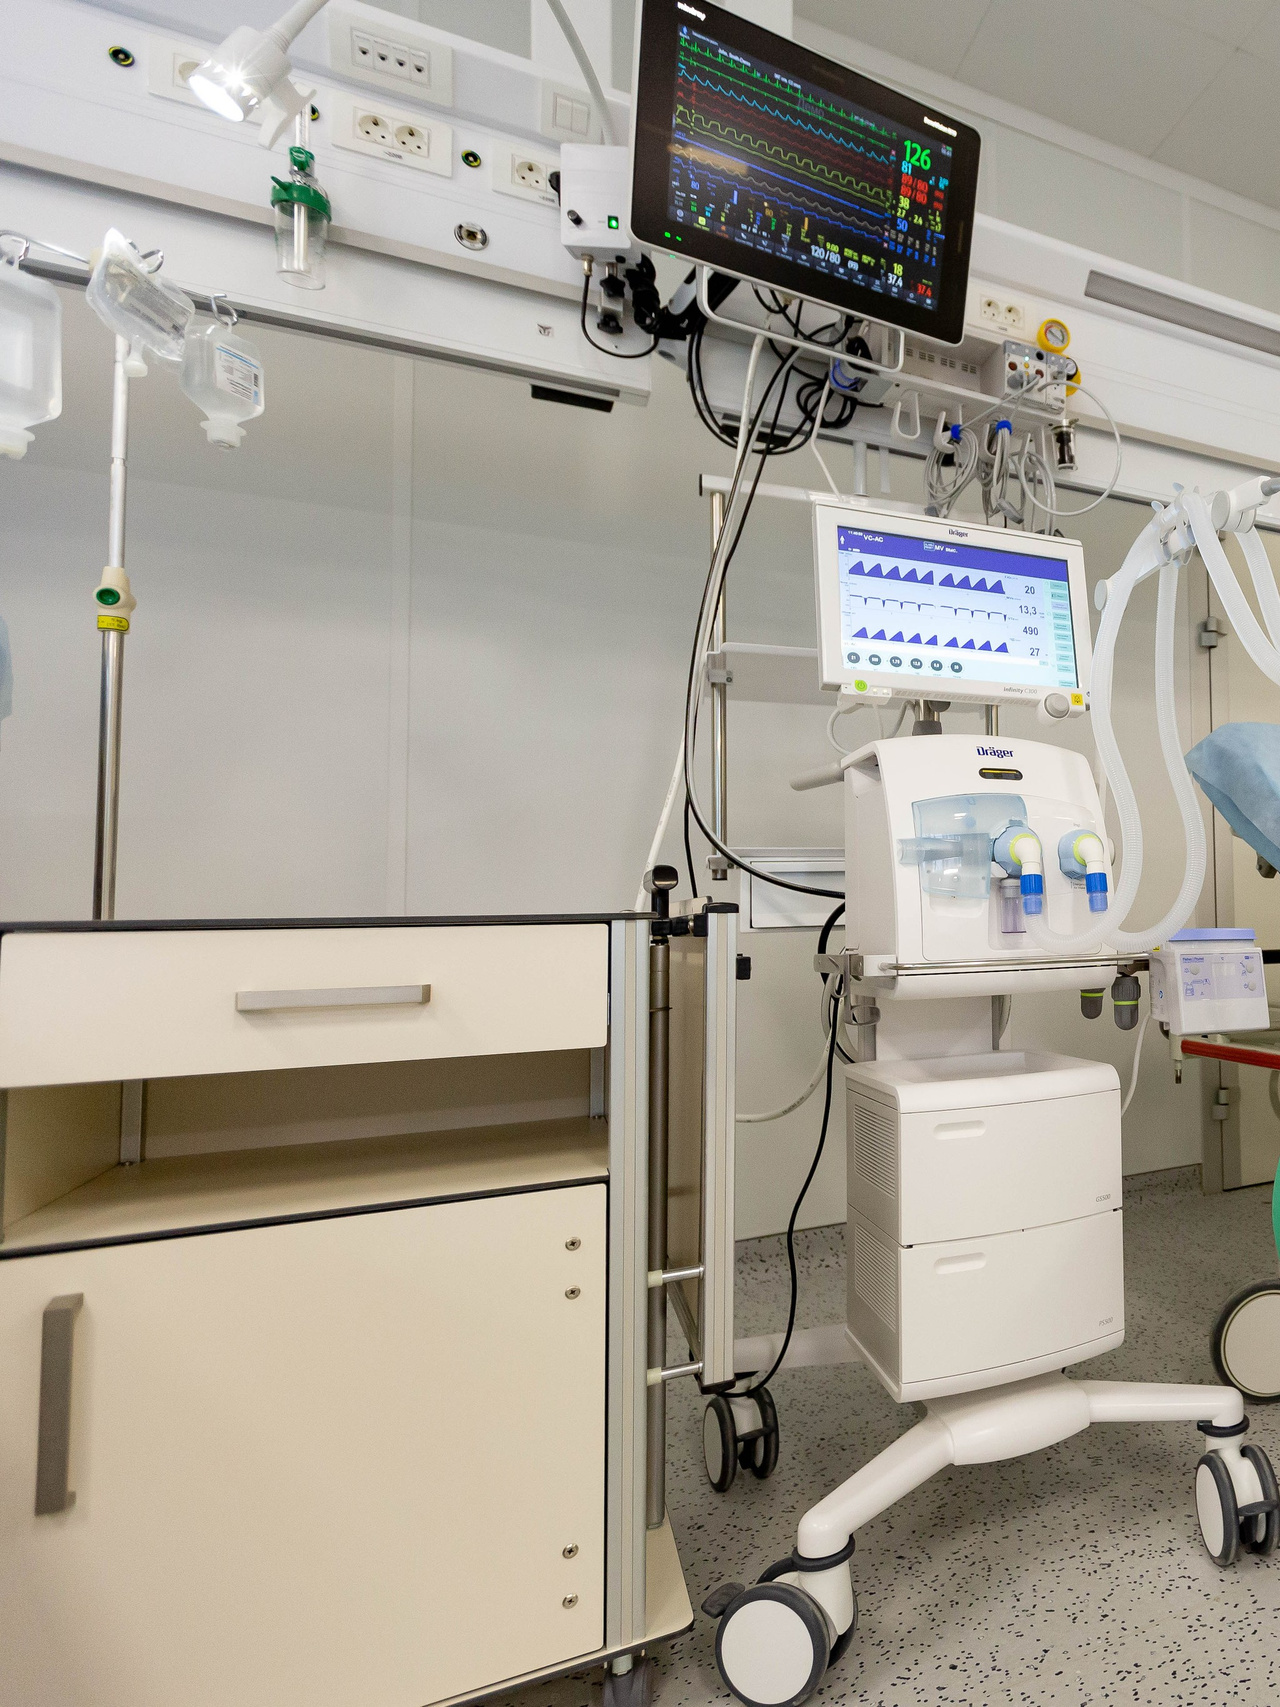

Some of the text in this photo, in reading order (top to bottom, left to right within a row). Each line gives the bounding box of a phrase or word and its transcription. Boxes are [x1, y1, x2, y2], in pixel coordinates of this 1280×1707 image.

[904, 140, 931, 170] 126
[901, 160, 912, 175] 81
[896, 218, 908, 232] 50
[893, 262, 903, 276] 18
[887, 272, 903, 288] 37.4
[863, 534, 884, 543] VC-AC
[1024, 585, 1035, 595] 20
[1019, 605, 1037, 616] 13,3
[1022, 626, 1039, 636] 490
[1029, 647, 1040, 657] 27
[1003, 686, 1023, 694] Infinity
[976, 745, 1014, 759] Dräger
